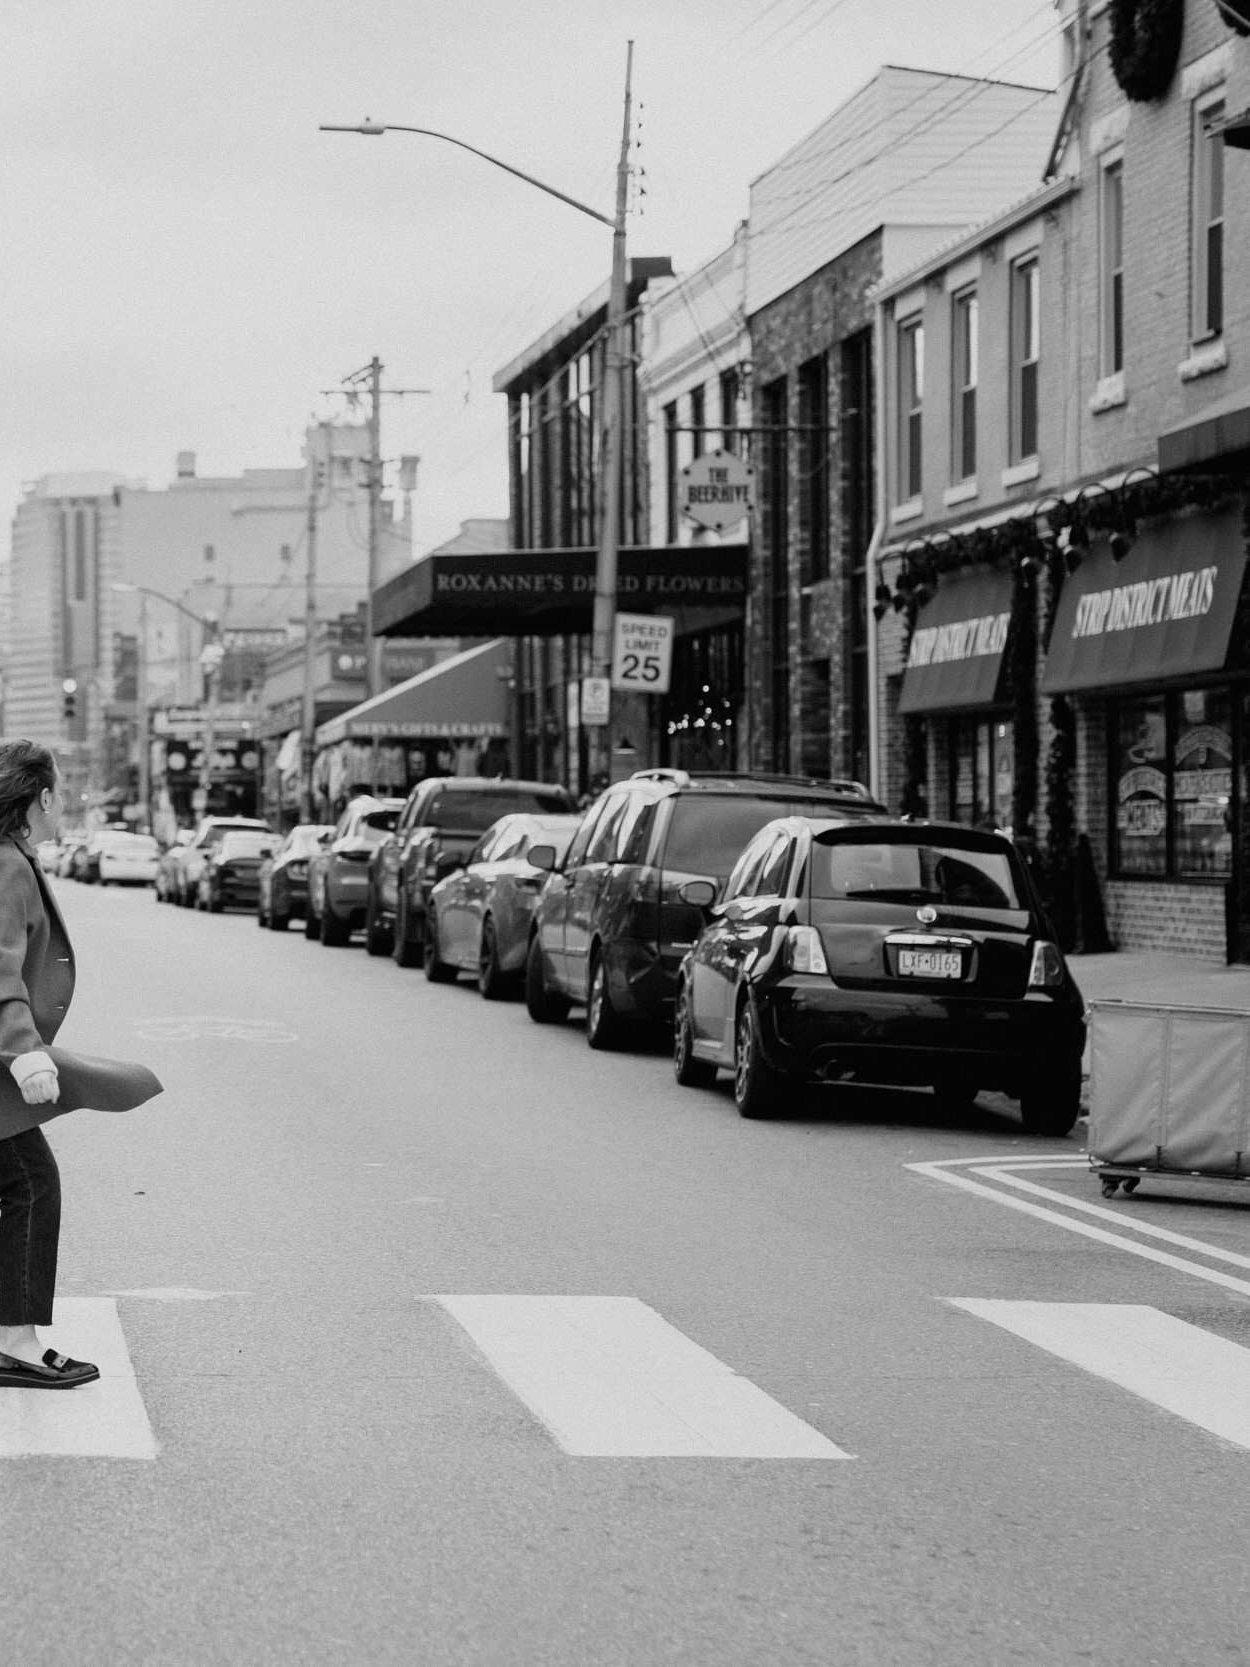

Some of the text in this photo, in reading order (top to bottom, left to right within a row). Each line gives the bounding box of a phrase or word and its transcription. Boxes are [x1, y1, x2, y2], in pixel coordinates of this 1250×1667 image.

[708, 467, 728, 482] THE
[436, 573, 745, 593] ROXANNE'S DRED FLOWERS
[1071, 565, 1219, 639] STRIP DISTRICT MEATS
[621, 622, 668, 638] SPEED
[625, 639, 660, 651] LIMIT
[621, 653, 661, 682] 25
[929, 953, 959, 971] 0165
